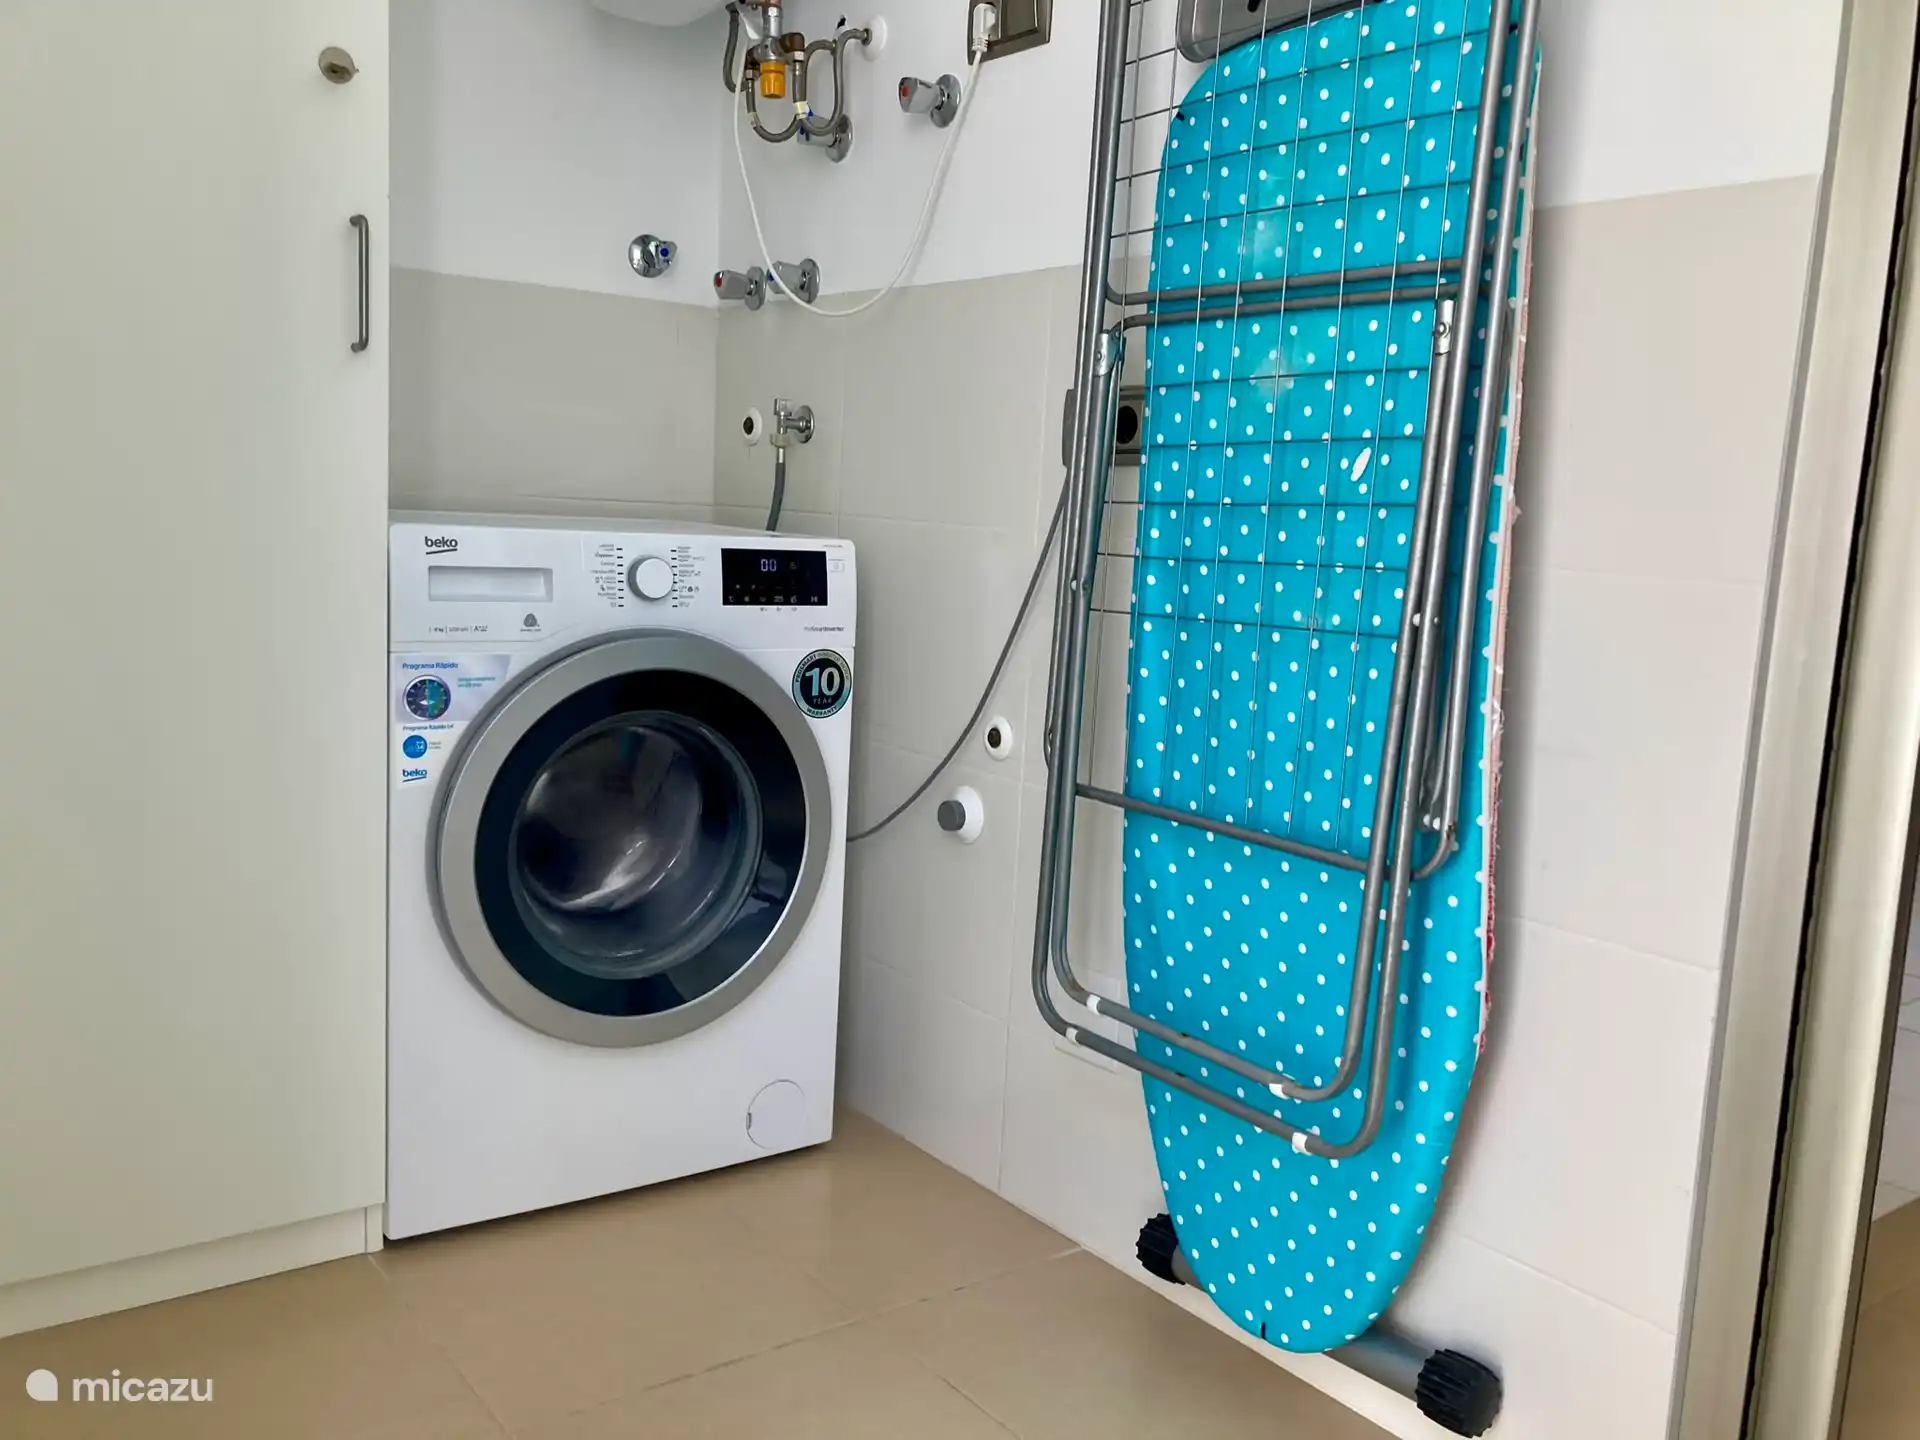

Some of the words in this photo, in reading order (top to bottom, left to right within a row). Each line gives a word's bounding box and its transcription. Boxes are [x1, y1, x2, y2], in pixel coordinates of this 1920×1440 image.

[424, 536, 458, 549] beko
[760, 559, 777, 571] 00
[795, 653, 817, 683] PROSMART
[805, 667, 840, 696] 10
[806, 706, 838, 716] WARRANTY
[402, 768, 428, 777] beko
